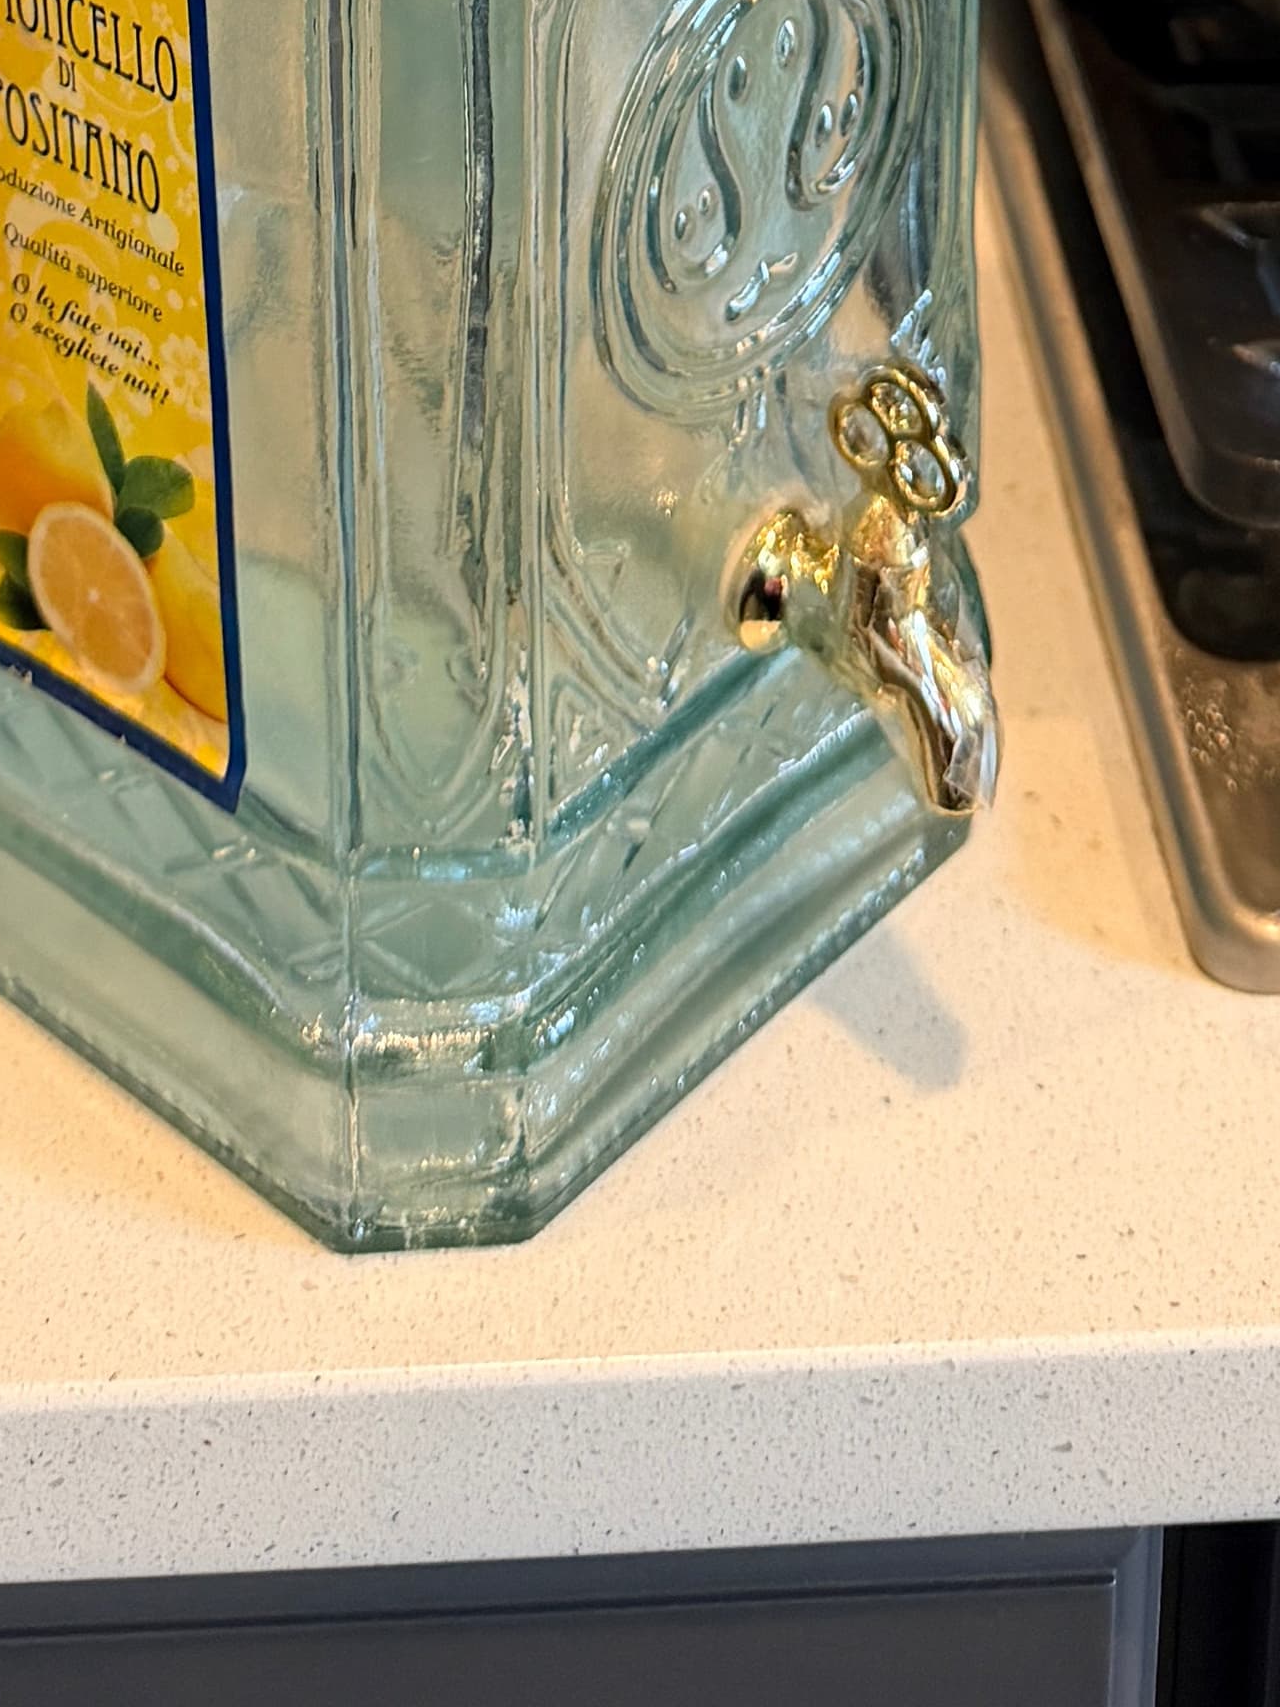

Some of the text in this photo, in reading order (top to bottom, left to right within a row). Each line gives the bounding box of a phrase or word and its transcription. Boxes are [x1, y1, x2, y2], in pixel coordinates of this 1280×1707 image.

[58, 56, 77, 92] DI
[80, 207, 185, 277] Artigianale
[13, 273, 30, 294] O
[76, 264, 163, 323] superiore
[10, 302, 28, 323] O
